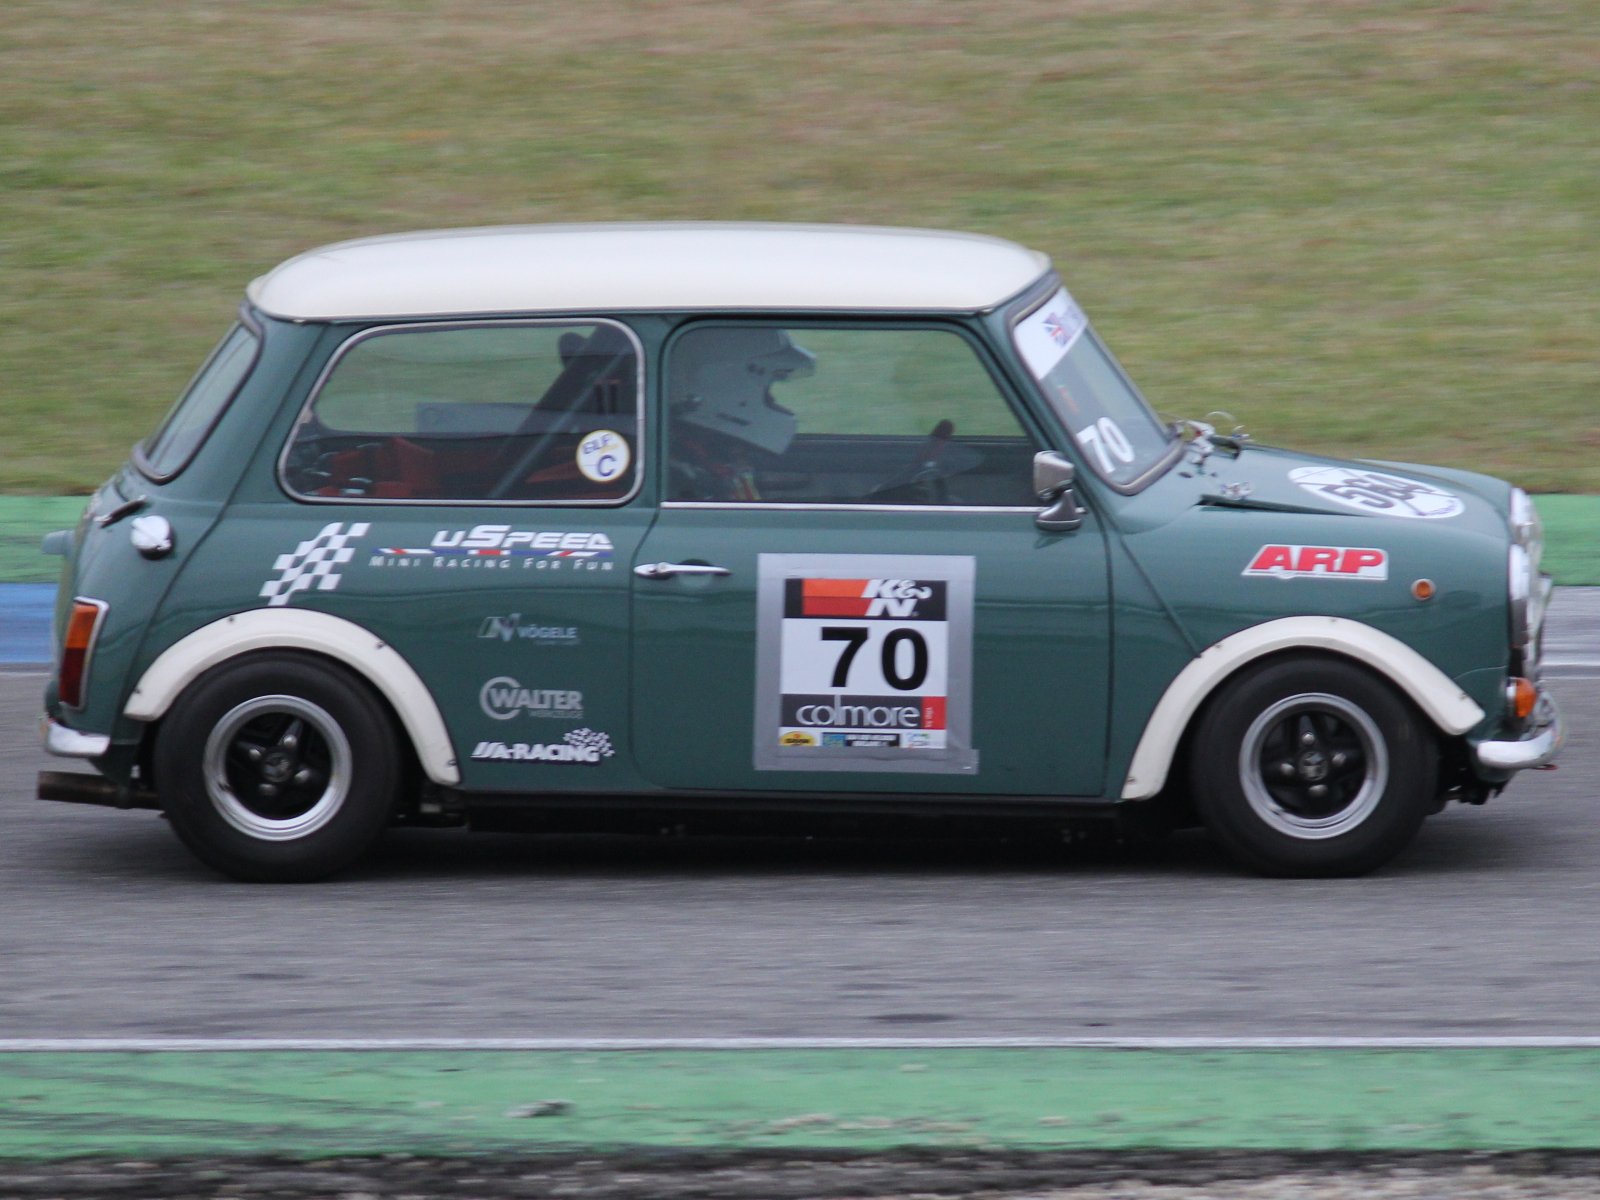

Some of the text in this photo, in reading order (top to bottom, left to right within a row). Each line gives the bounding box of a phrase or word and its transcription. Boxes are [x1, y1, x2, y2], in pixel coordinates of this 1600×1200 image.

[1076, 417, 1135, 473] 70
[597, 455, 616, 477] C
[1250, 546, 1384, 573] ARP
[821, 626, 929, 691] 70
[488, 689, 583, 709] WALTER
[796, 695, 920, 727] colmore
